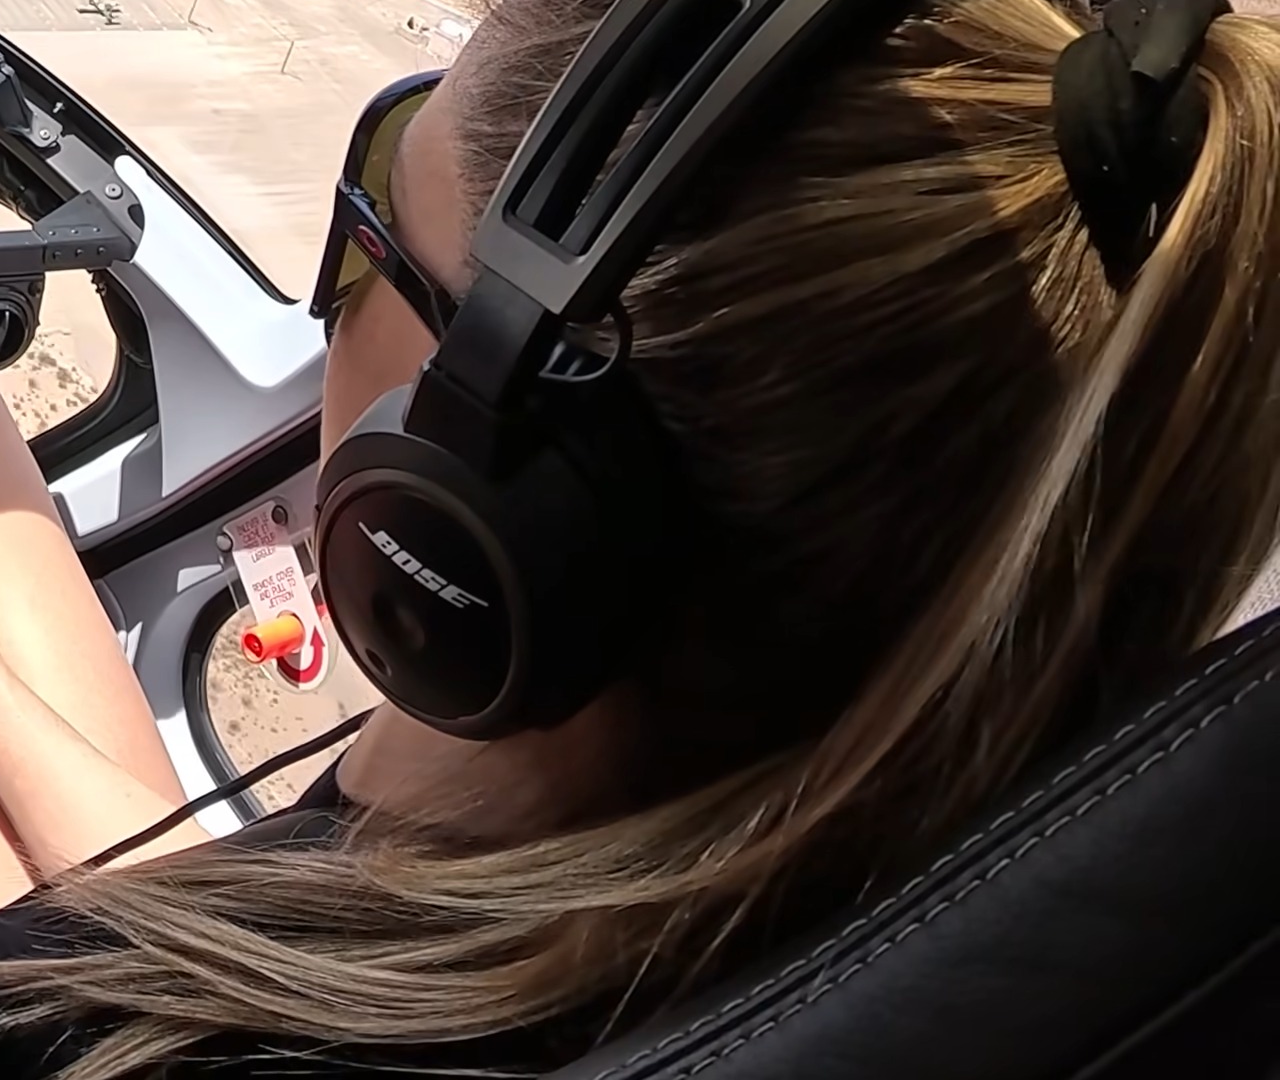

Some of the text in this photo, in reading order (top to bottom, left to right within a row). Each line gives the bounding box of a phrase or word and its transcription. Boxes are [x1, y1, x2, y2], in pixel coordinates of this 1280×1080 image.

[252, 567, 294, 592] REMOVE COVER
[358, 521, 489, 608] BOSE
